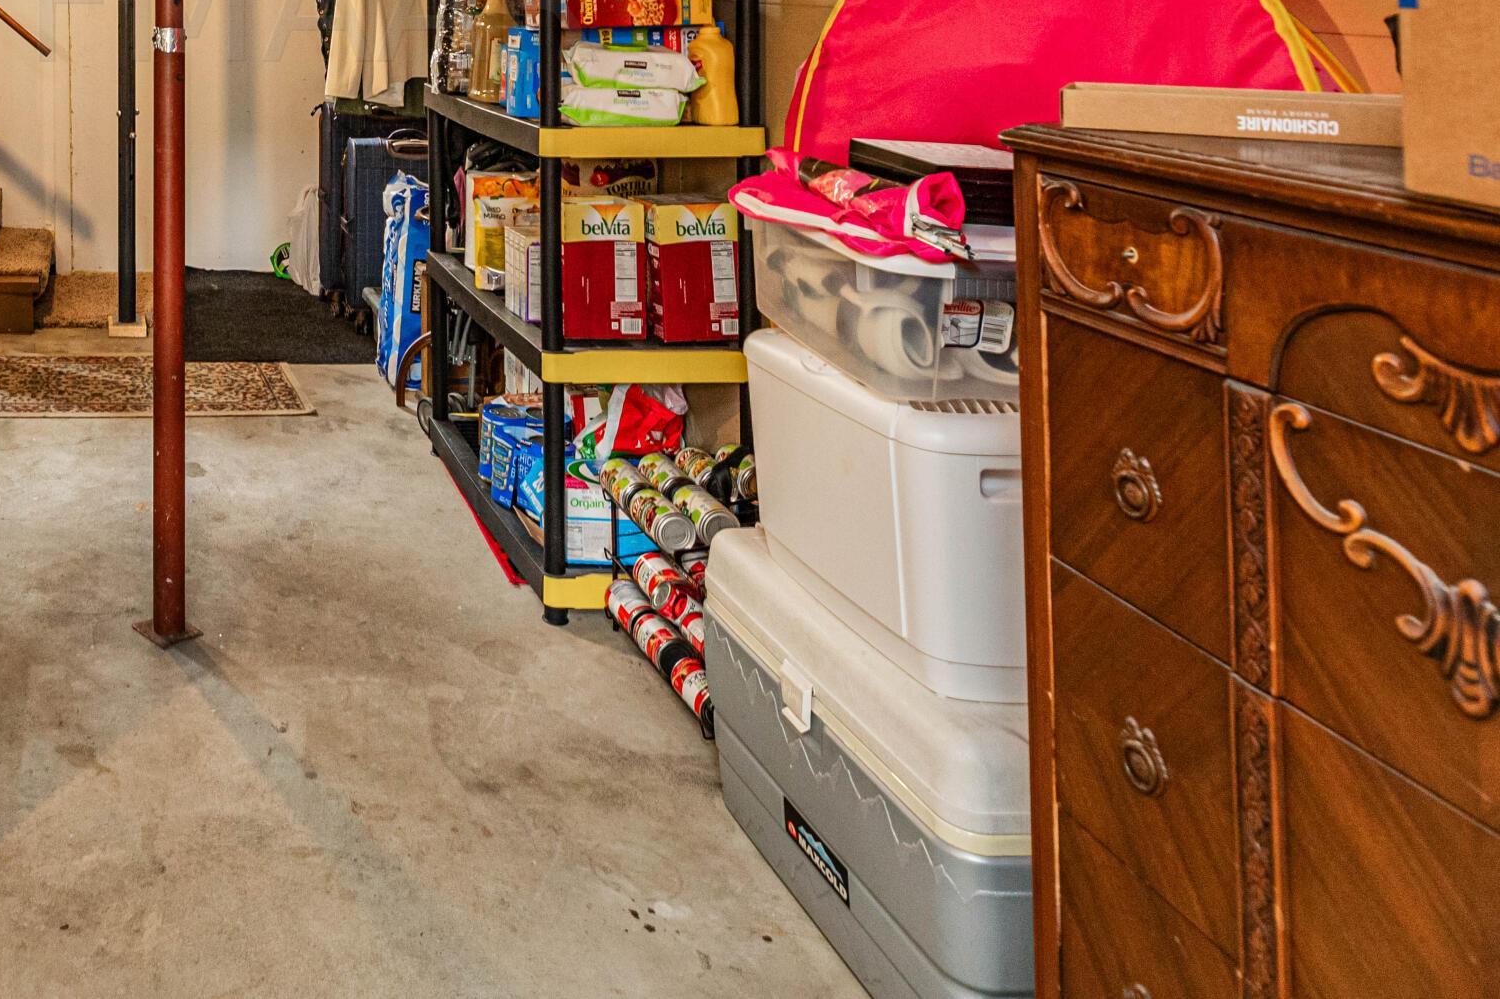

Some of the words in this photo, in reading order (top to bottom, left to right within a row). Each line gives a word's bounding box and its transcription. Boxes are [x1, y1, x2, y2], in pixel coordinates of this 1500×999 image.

[1236, 115, 1340, 137] CUSHIONAIRE
[581, 214, 631, 236] belVita
[676, 214, 726, 237] belVita
[570, 498, 605, 510] Orgain
[798, 834, 848, 901] MAXCOLD
